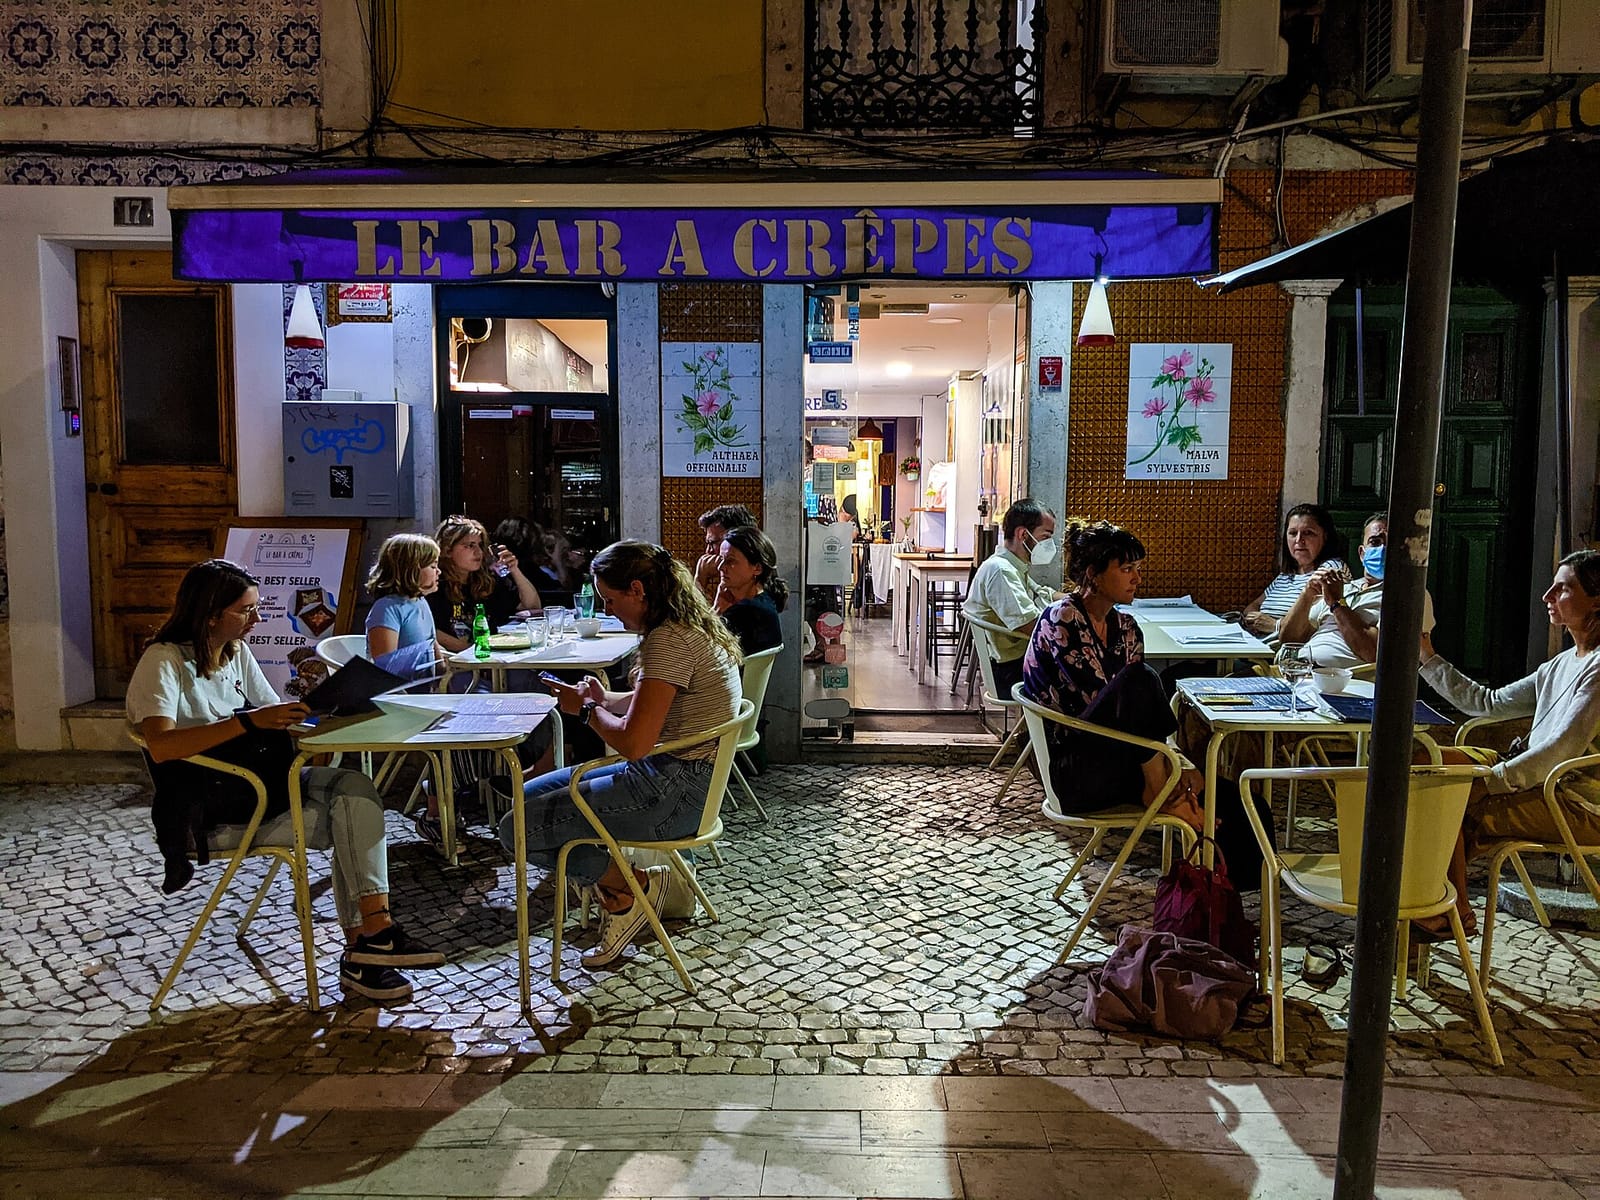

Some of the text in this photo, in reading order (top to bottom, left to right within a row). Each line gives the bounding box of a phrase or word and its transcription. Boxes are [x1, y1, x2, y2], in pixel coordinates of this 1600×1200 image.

[124, 200, 142, 224] 17
[353, 208, 1035, 278] LE BAR A CRÊPES
[825, 390, 838, 403] G
[711, 451, 759, 461] ALTHAEA
[1186, 449, 1220, 461] MALVA
[686, 462, 747, 473] OFFICINALIS
[1146, 464, 1211, 474] SYLVESTRIS
[264, 576, 287, 586] BEST
[289, 576, 321, 587] SELLER
[249, 635, 307, 646] BEST SELLER
